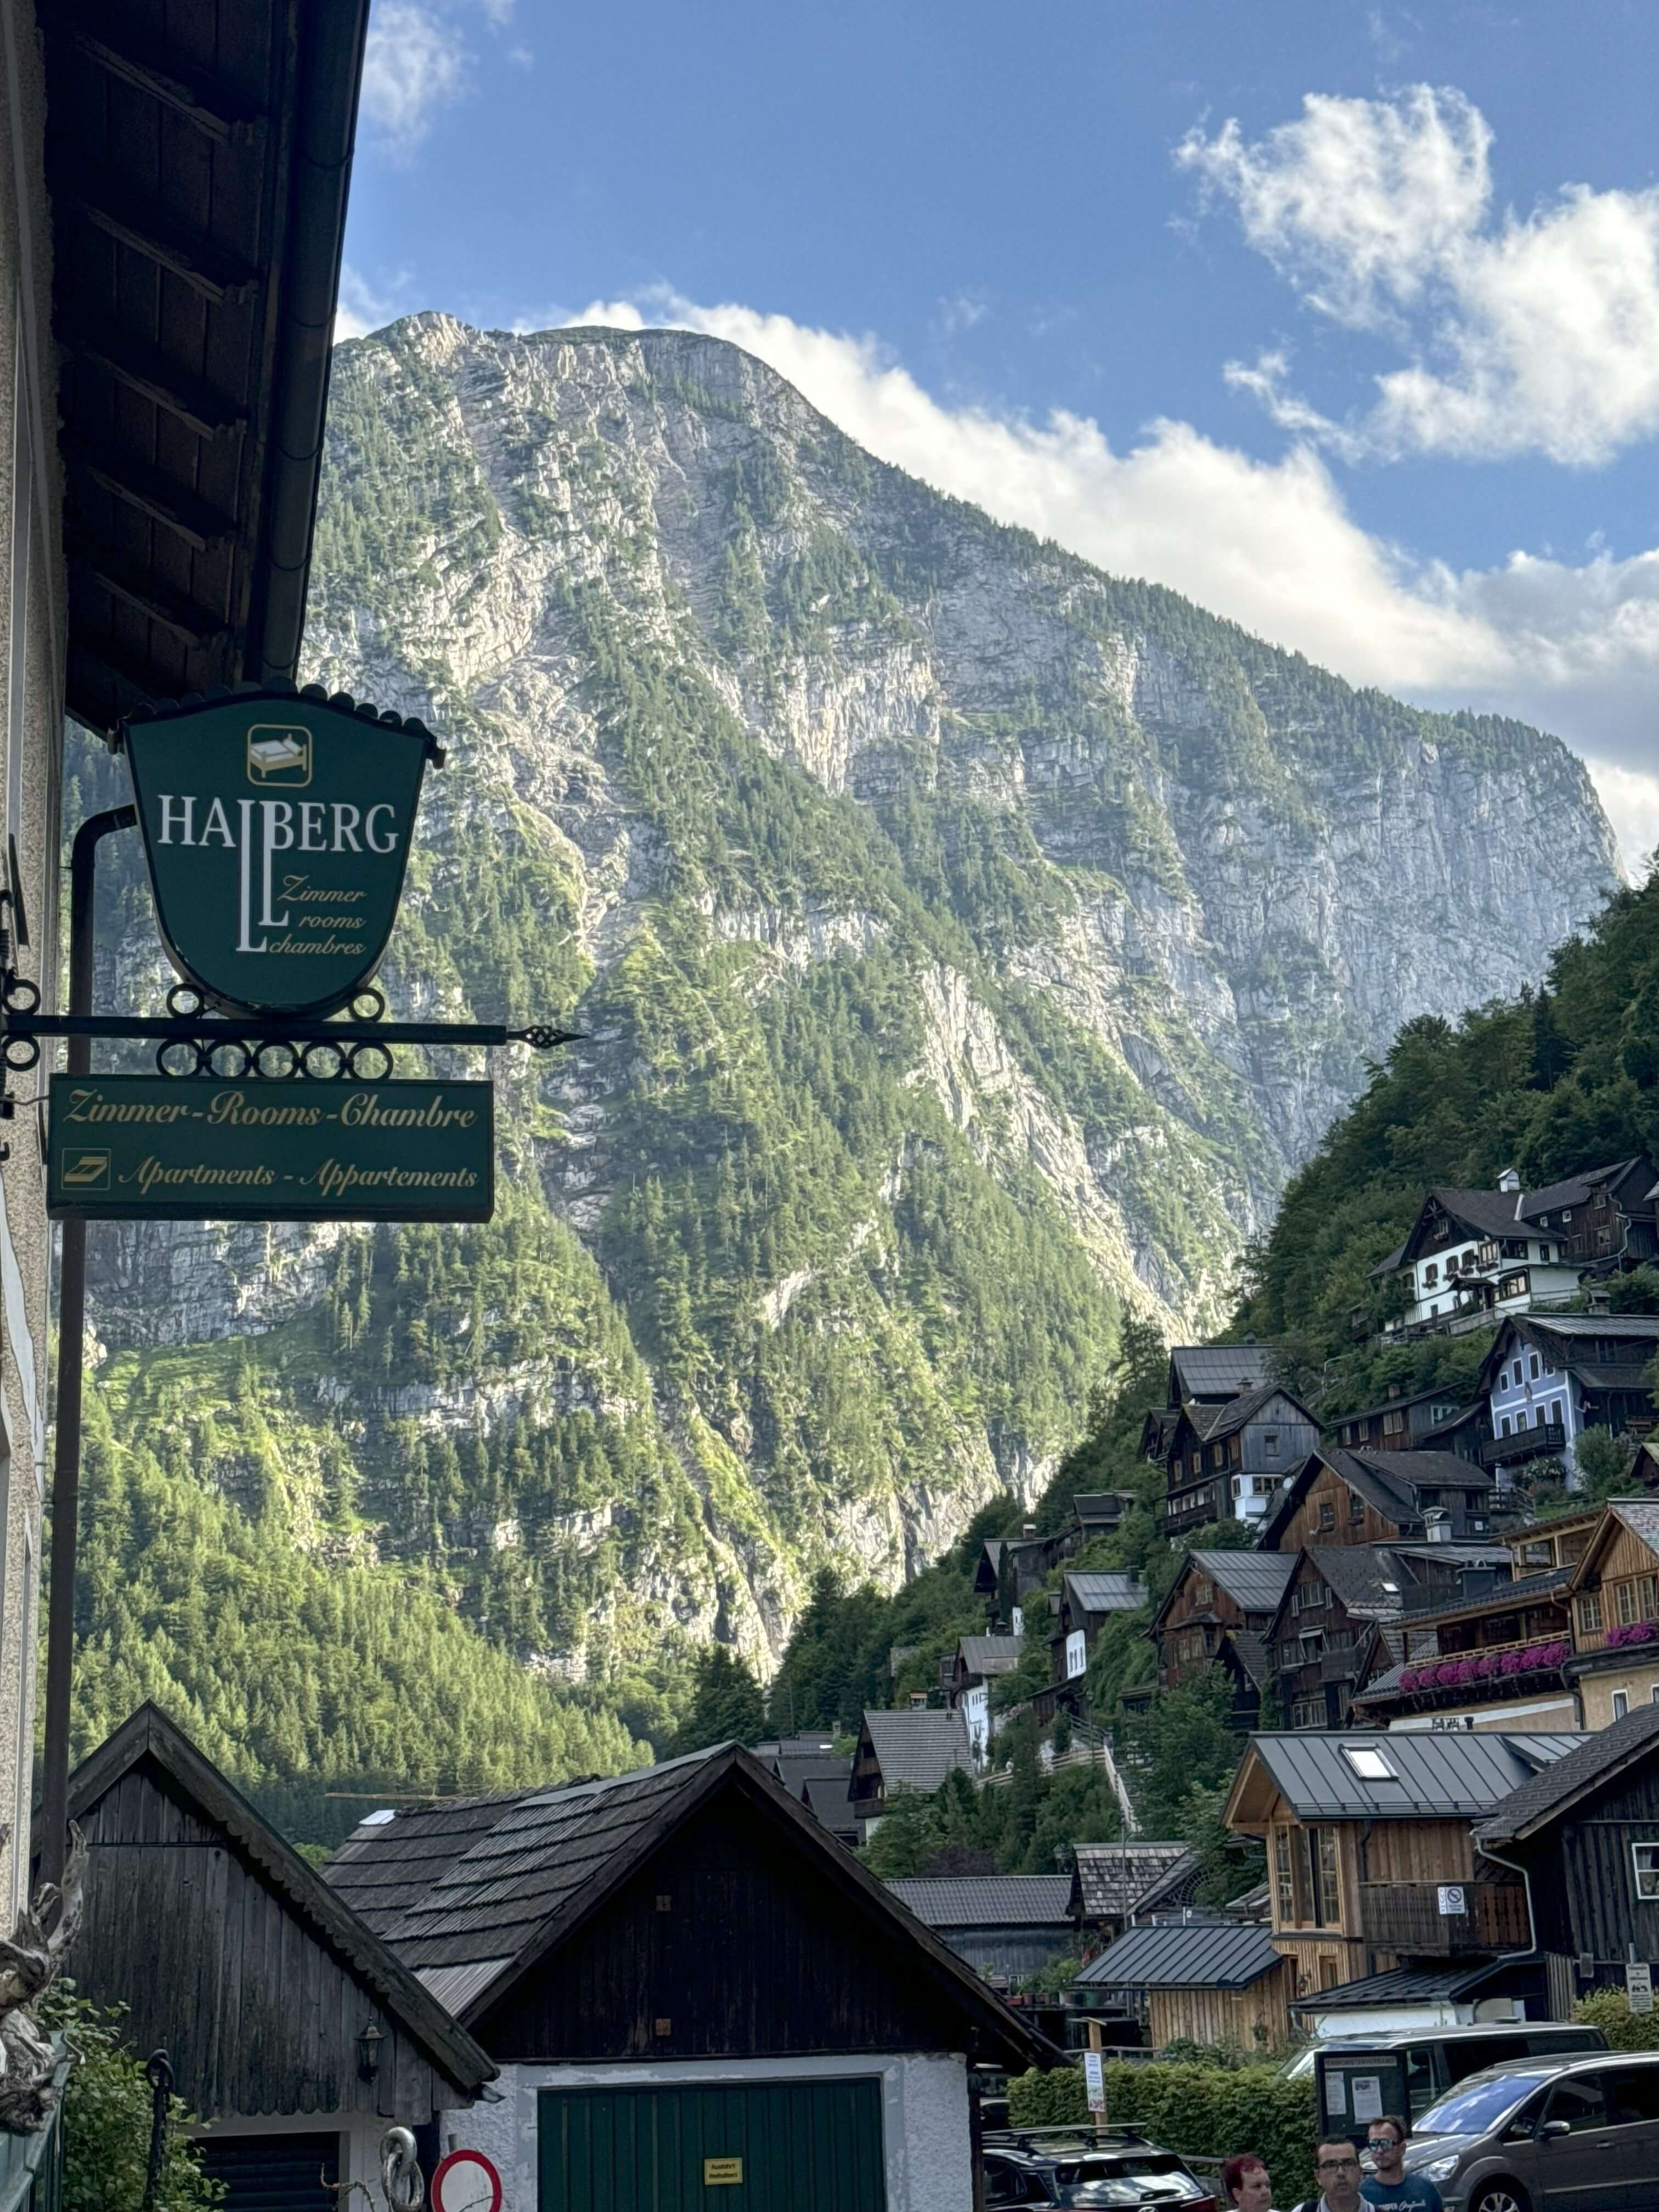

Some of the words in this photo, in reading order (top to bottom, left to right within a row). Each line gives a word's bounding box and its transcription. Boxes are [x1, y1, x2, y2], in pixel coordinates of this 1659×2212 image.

[157, 794, 399, 952] HALLBERG
[277, 875, 367, 902] Zimmer
[298, 916, 366, 928] rooms
[269, 934, 366, 954] chambres
[119, 1156, 276, 1194] Apartments
[300, 1159, 478, 1197] Appartements
